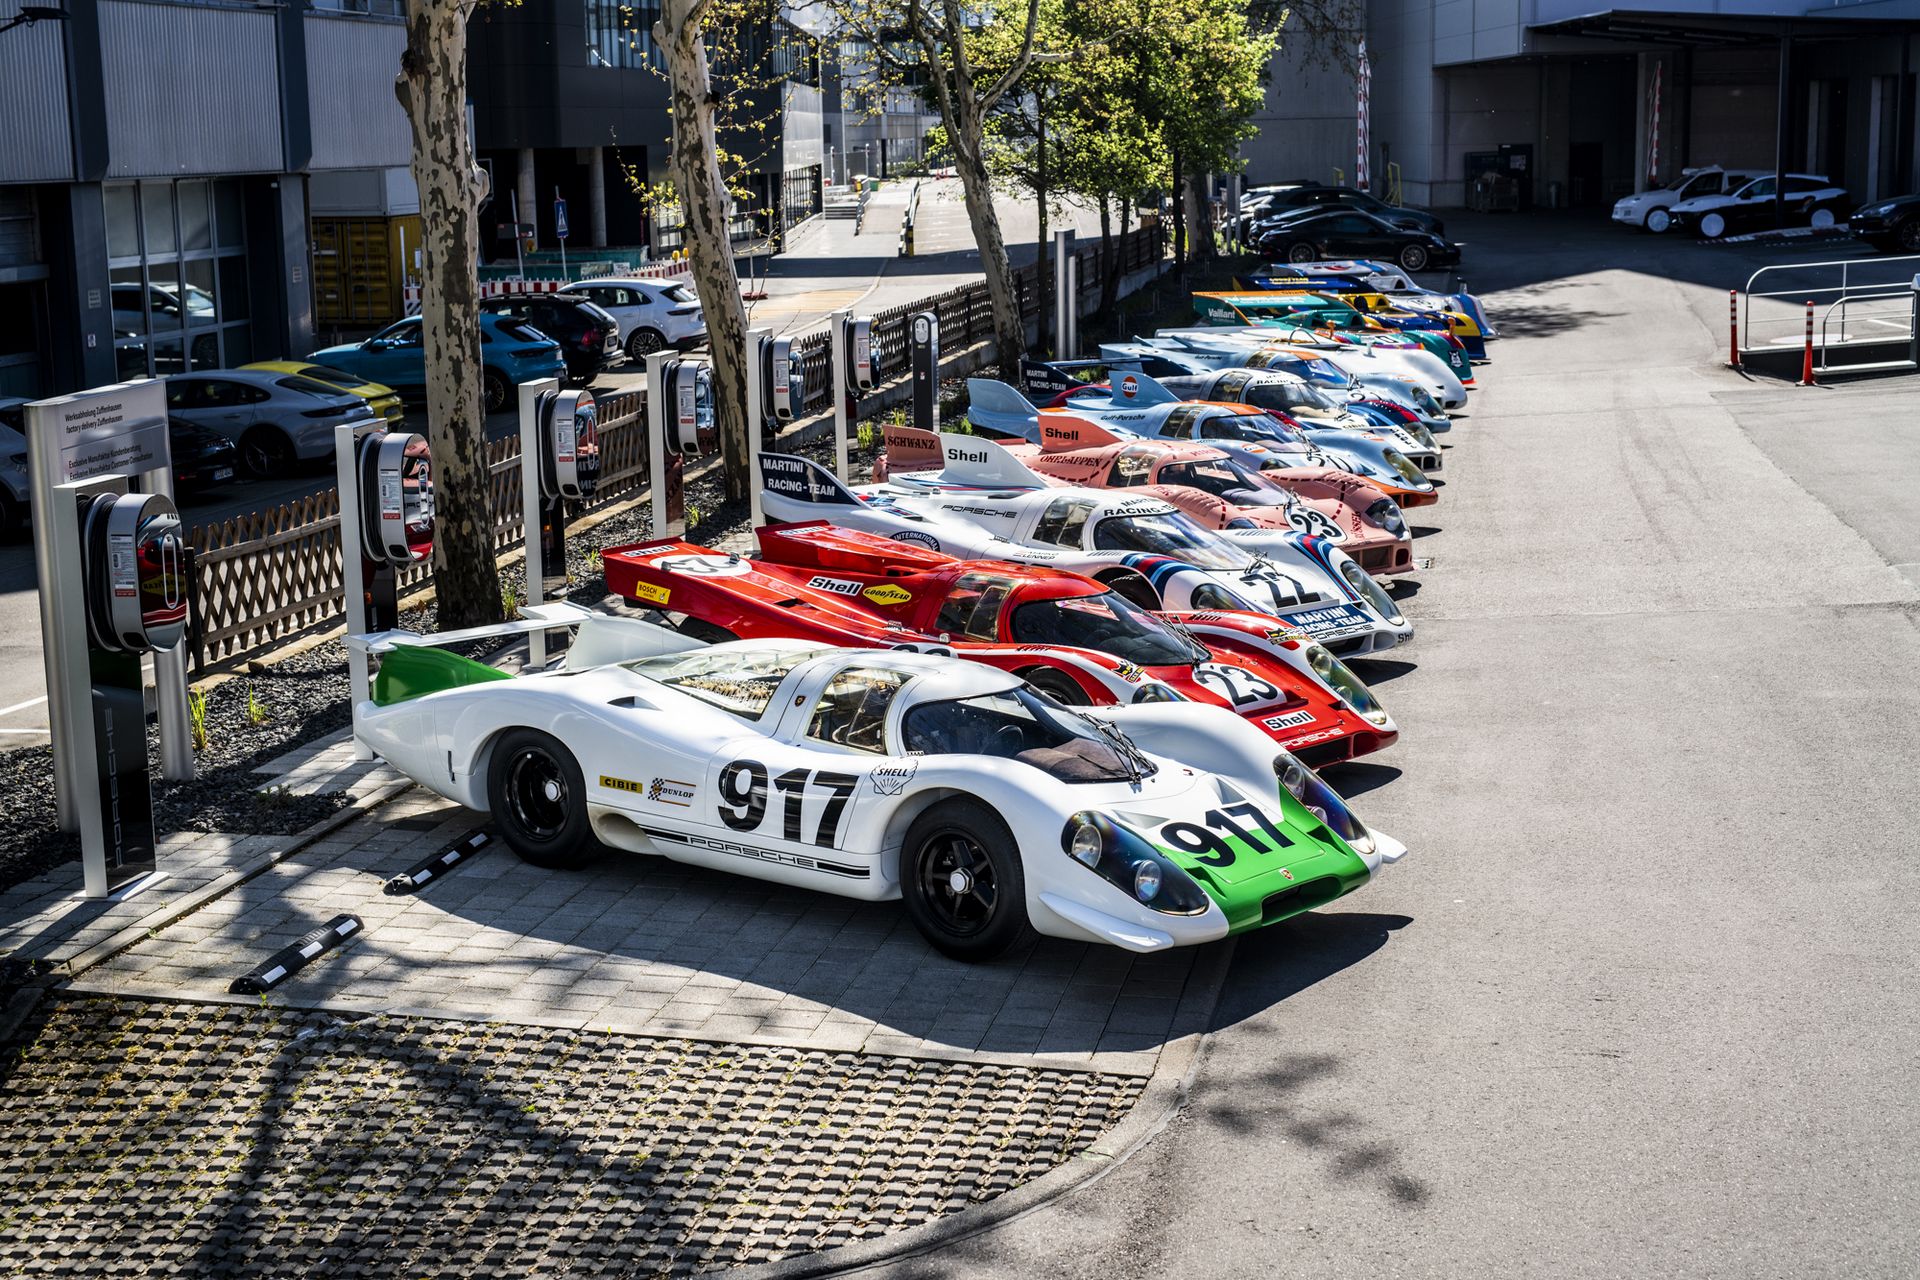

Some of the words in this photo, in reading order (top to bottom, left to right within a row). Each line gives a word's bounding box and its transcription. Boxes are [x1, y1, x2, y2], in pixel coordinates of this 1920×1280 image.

[1208, 308, 1235, 320] Vaillant
[1026, 369, 1048, 379] MARTINI
[1030, 380, 1067, 391] RACING-TEAM
[1121, 382, 1138, 392] Gulf
[65, 408, 96, 422] Werksabholung
[96, 403, 122, 414] Zuffenhausen
[66, 425, 81, 434] factory
[81, 420, 97, 431] delivery
[97, 415, 123, 426] Zuffenhausen
[887, 435, 936, 450] SCHWANZ
[1045, 427, 1079, 441] Shell
[69, 457, 87, 468] Exclusive
[87, 451, 110, 464] Manufaktur
[110, 444, 142, 457] Kundenberatung
[948, 448, 988, 463] Shell
[70, 469, 88, 480] Exclusive
[88, 463, 111, 475] Manufaktur
[111, 458, 129, 469] Customer
[129, 452, 153, 464] Consultation
[763, 458, 804, 473] MARTINI
[768, 478, 836, 497] RACING-TEAM
[942, 504, 1018, 519] PORSCHE
[1290, 511, 1342, 539] 23
[625, 545, 675, 557] Shell
[638, 584, 658, 595] BOSCH
[809, 577, 861, 595] Shell
[1291, 606, 1350, 624] MARTINI
[1196, 665, 1278, 706] 23
[1266, 711, 1313, 729] Shell
[1279, 727, 1345, 749] PORSCHE
[876, 767, 908, 778] SHELL
[104, 707, 124, 868] PORSCHE
[604, 778, 638, 791] CIBIE
[662, 787, 694, 799] DUNLOP
[717, 758, 859, 849] 917
[1160, 802, 1295, 867] 917
[688, 837, 815, 867] PORSCHE
